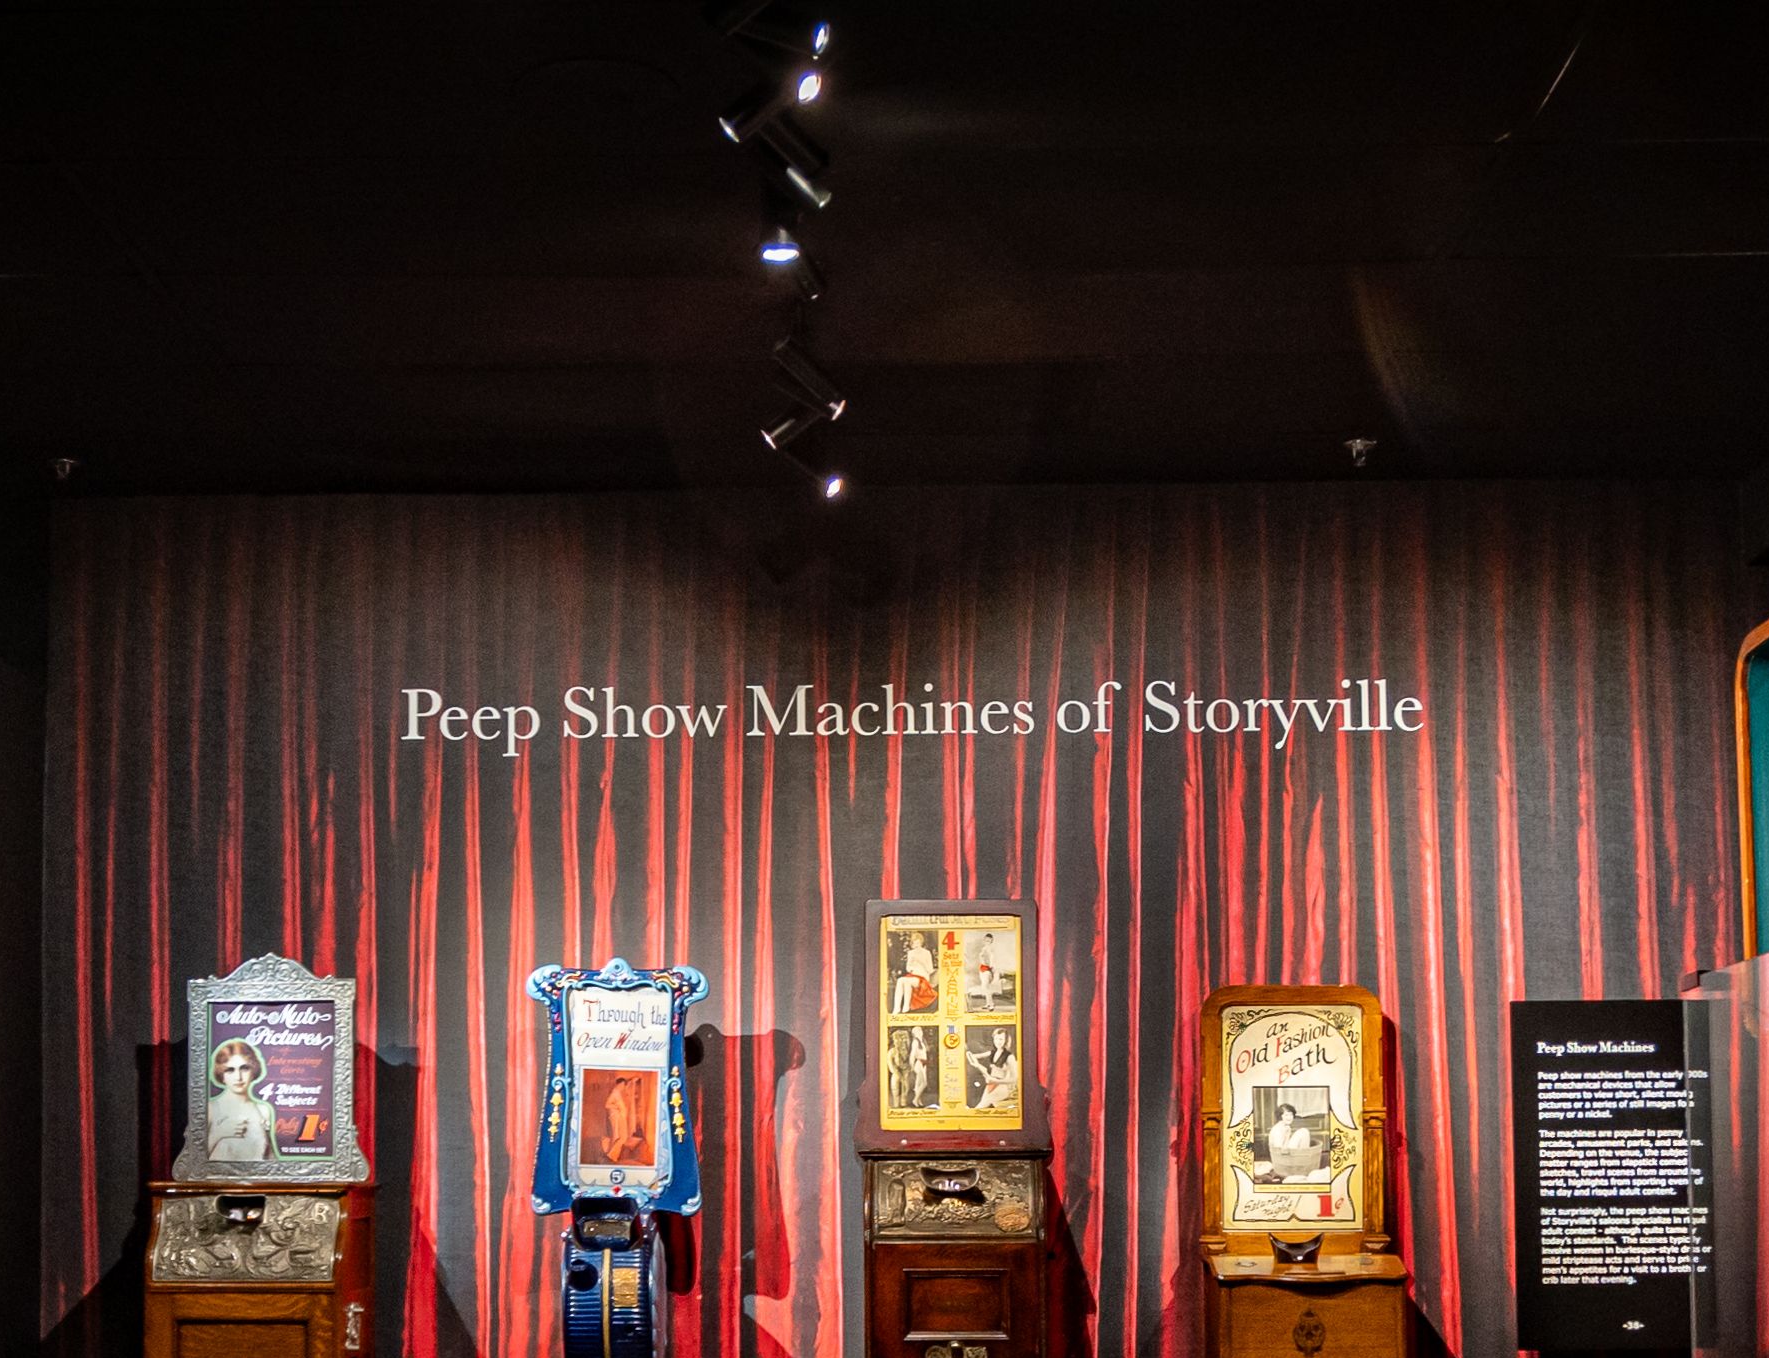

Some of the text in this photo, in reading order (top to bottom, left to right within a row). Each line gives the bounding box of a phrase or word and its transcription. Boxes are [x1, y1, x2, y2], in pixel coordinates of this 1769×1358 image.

[401, 679, 1425, 757] Peep Show Machines of Storyville
[942, 931, 960, 950] 4
[583, 999, 645, 1032] Through
[245, 1026, 334, 1051] Pictures
[1266, 1021, 1289, 1038] an
[577, 1032, 667, 1051] Open Window
[1236, 1023, 1334, 1074] Old Fashion
[1536, 1040, 1656, 1056] Peep Show Machines
[1278, 1043, 1338, 1085] Bath
[259, 1083, 275, 1101] 4
